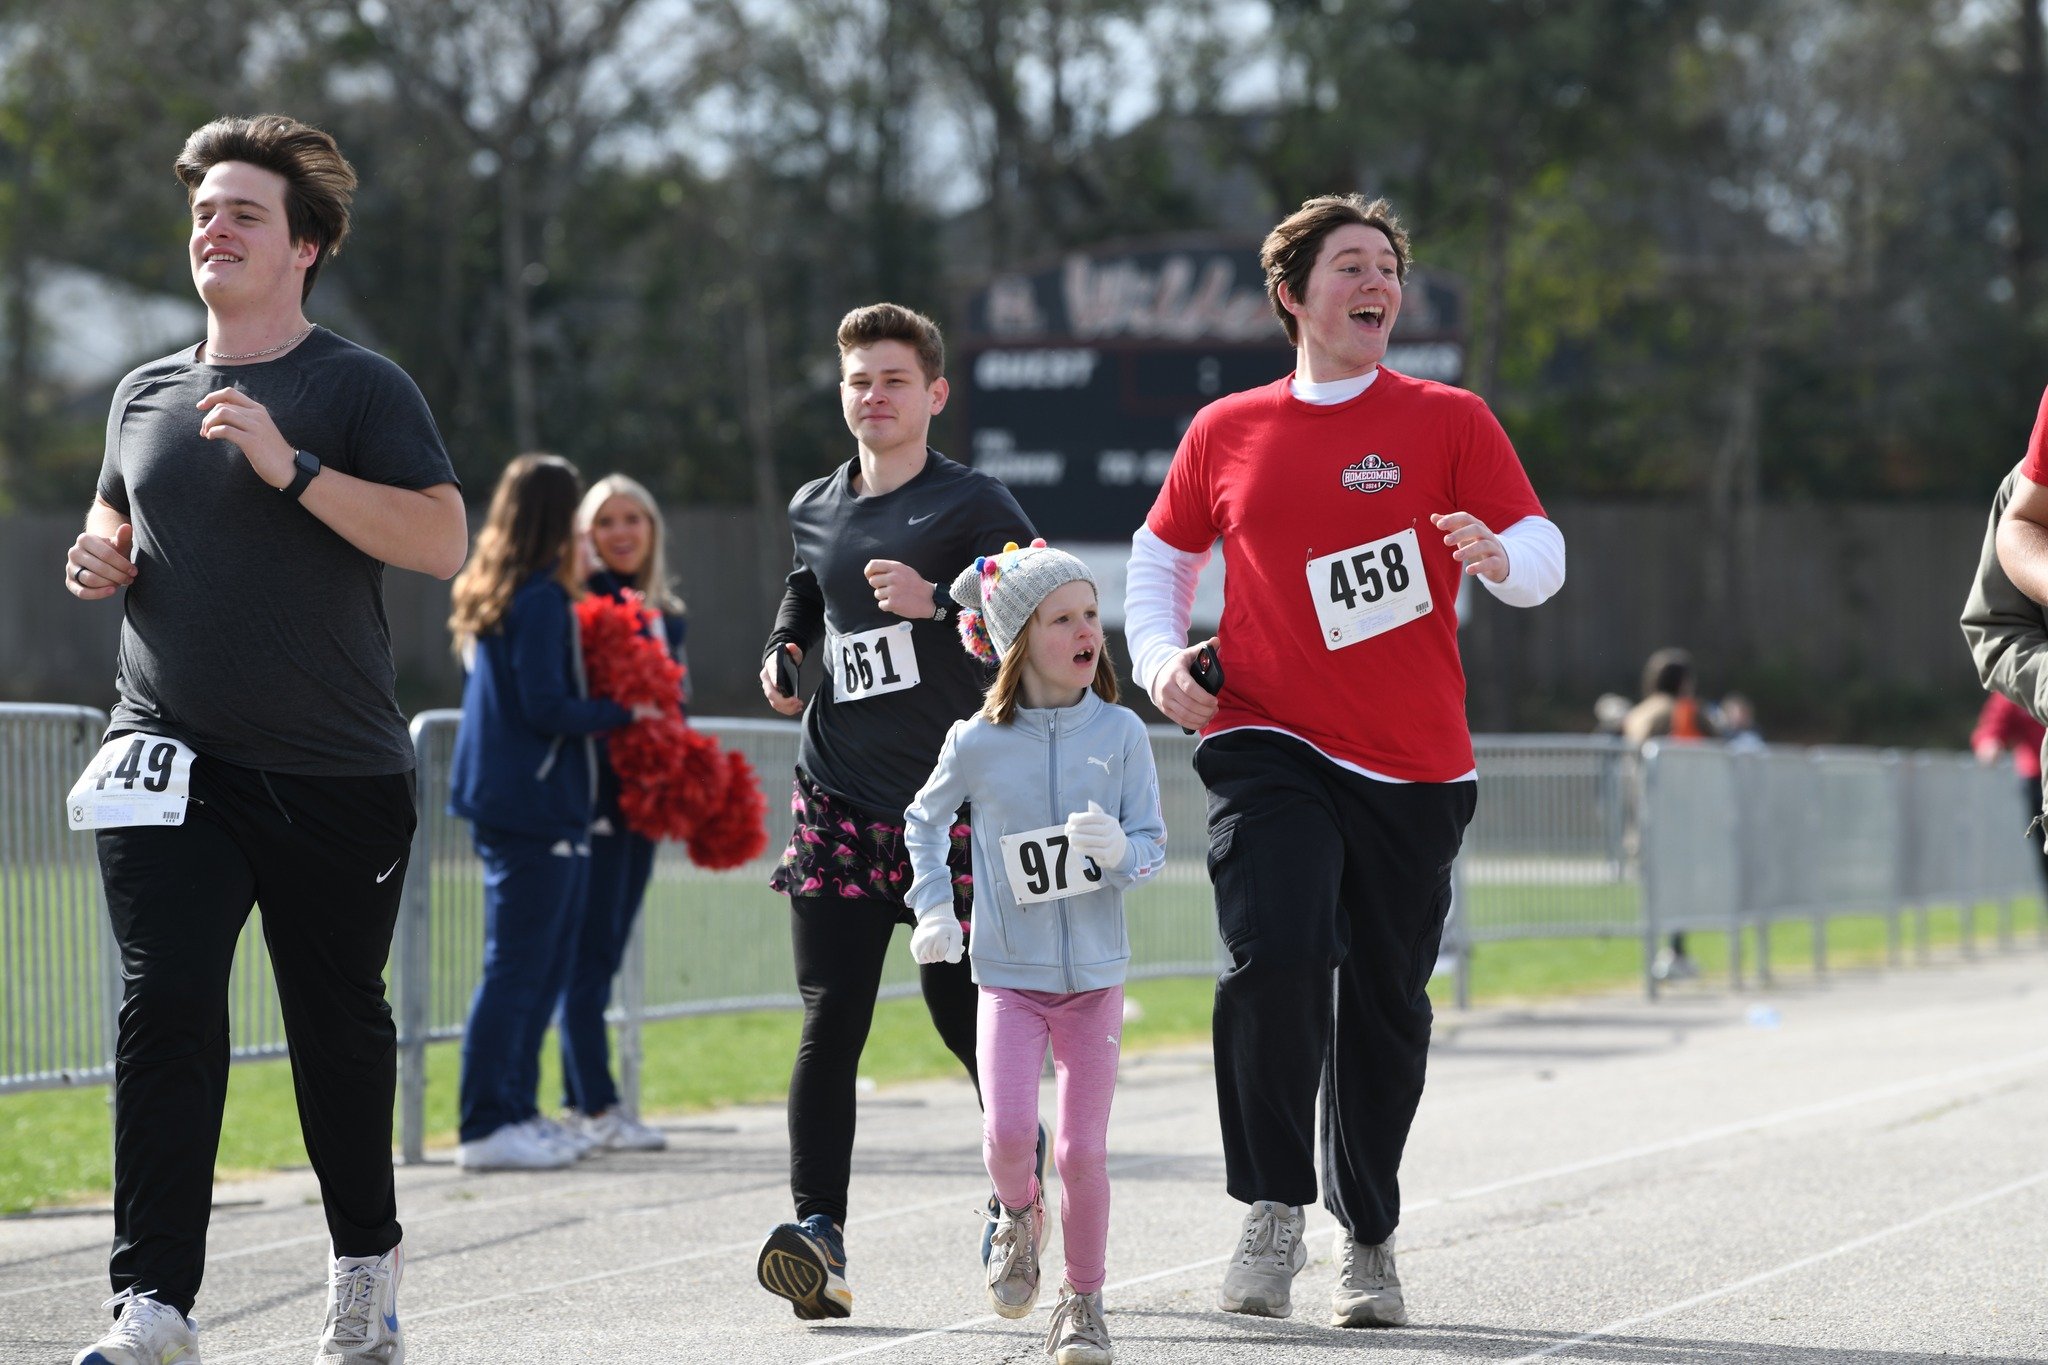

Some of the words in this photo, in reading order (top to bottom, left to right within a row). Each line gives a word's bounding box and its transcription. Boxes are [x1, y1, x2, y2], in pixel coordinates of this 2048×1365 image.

[1345, 469, 1397, 483] HOMECOMING
[1330, 543, 1409, 610] 458
[843, 637, 901, 693] 661
